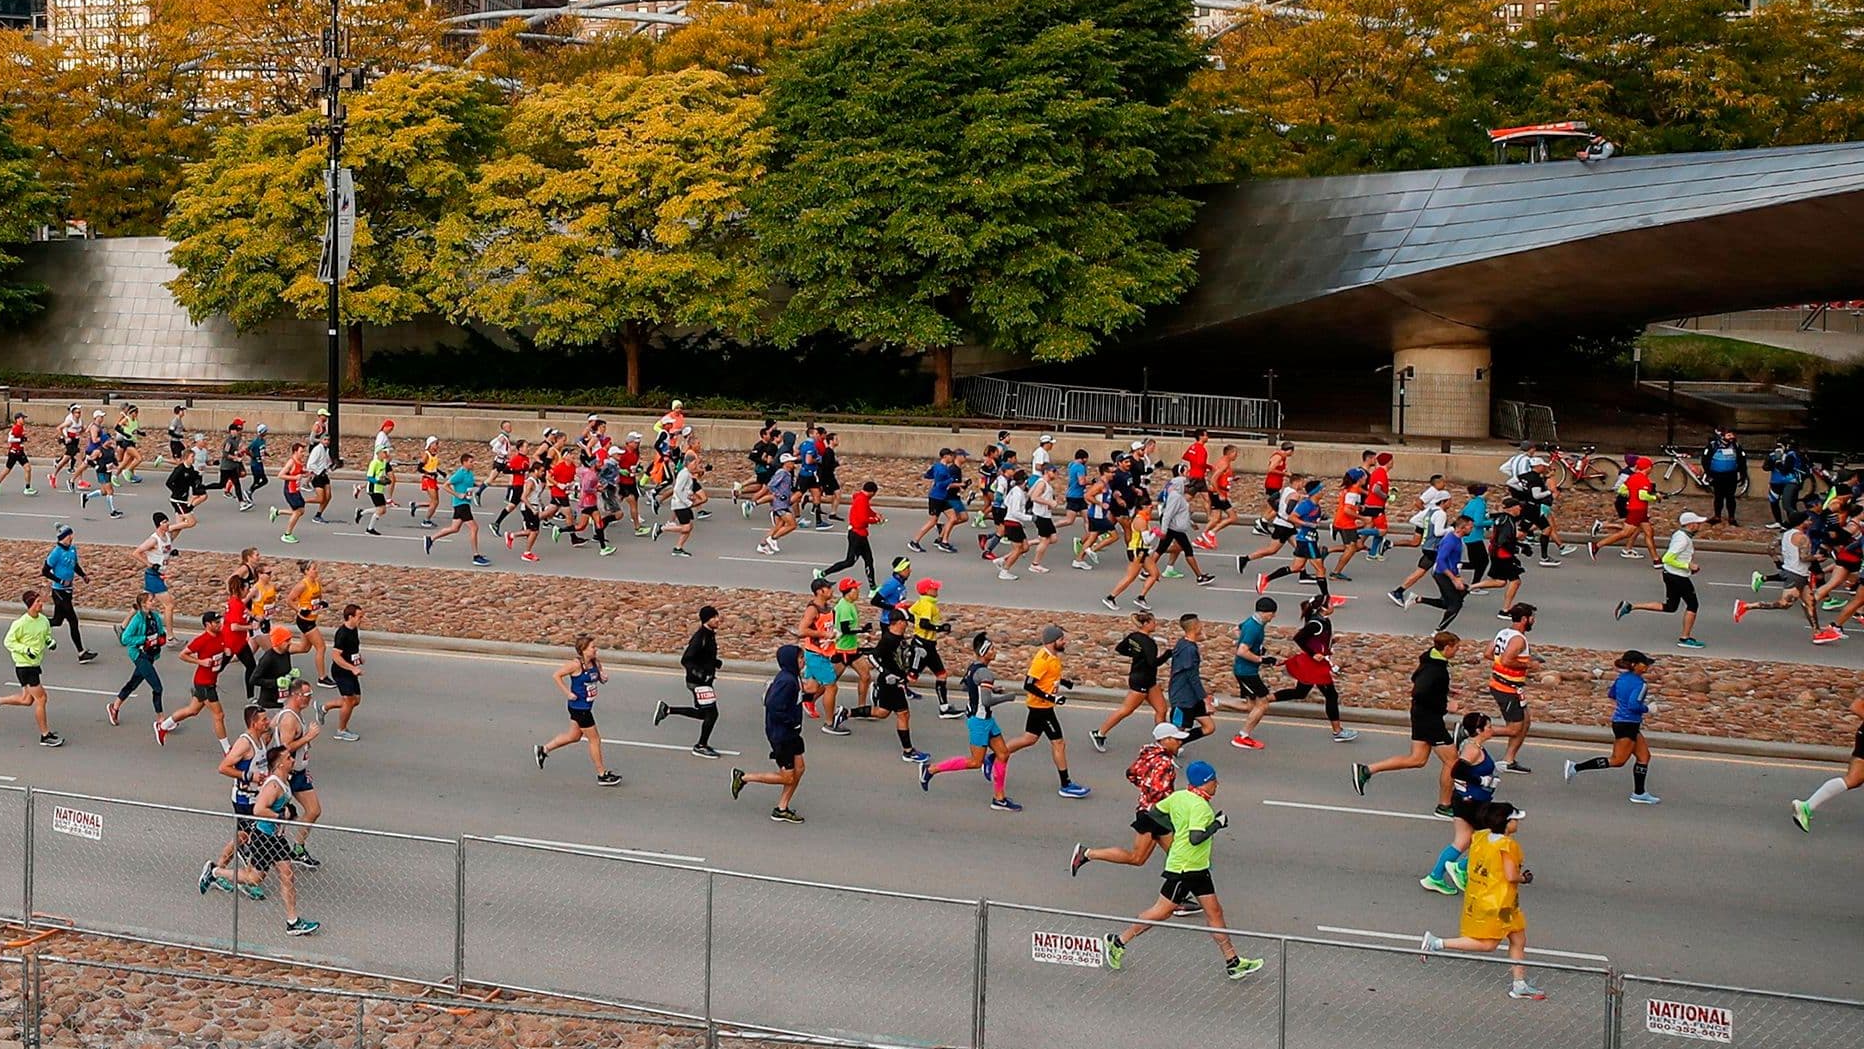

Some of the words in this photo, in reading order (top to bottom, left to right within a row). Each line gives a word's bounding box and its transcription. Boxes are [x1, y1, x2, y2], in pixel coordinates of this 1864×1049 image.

[55, 807, 101, 827] NATIONAL
[1034, 933, 1101, 953] NATIONAL
[1649, 1000, 1731, 1026] NATIONAL
